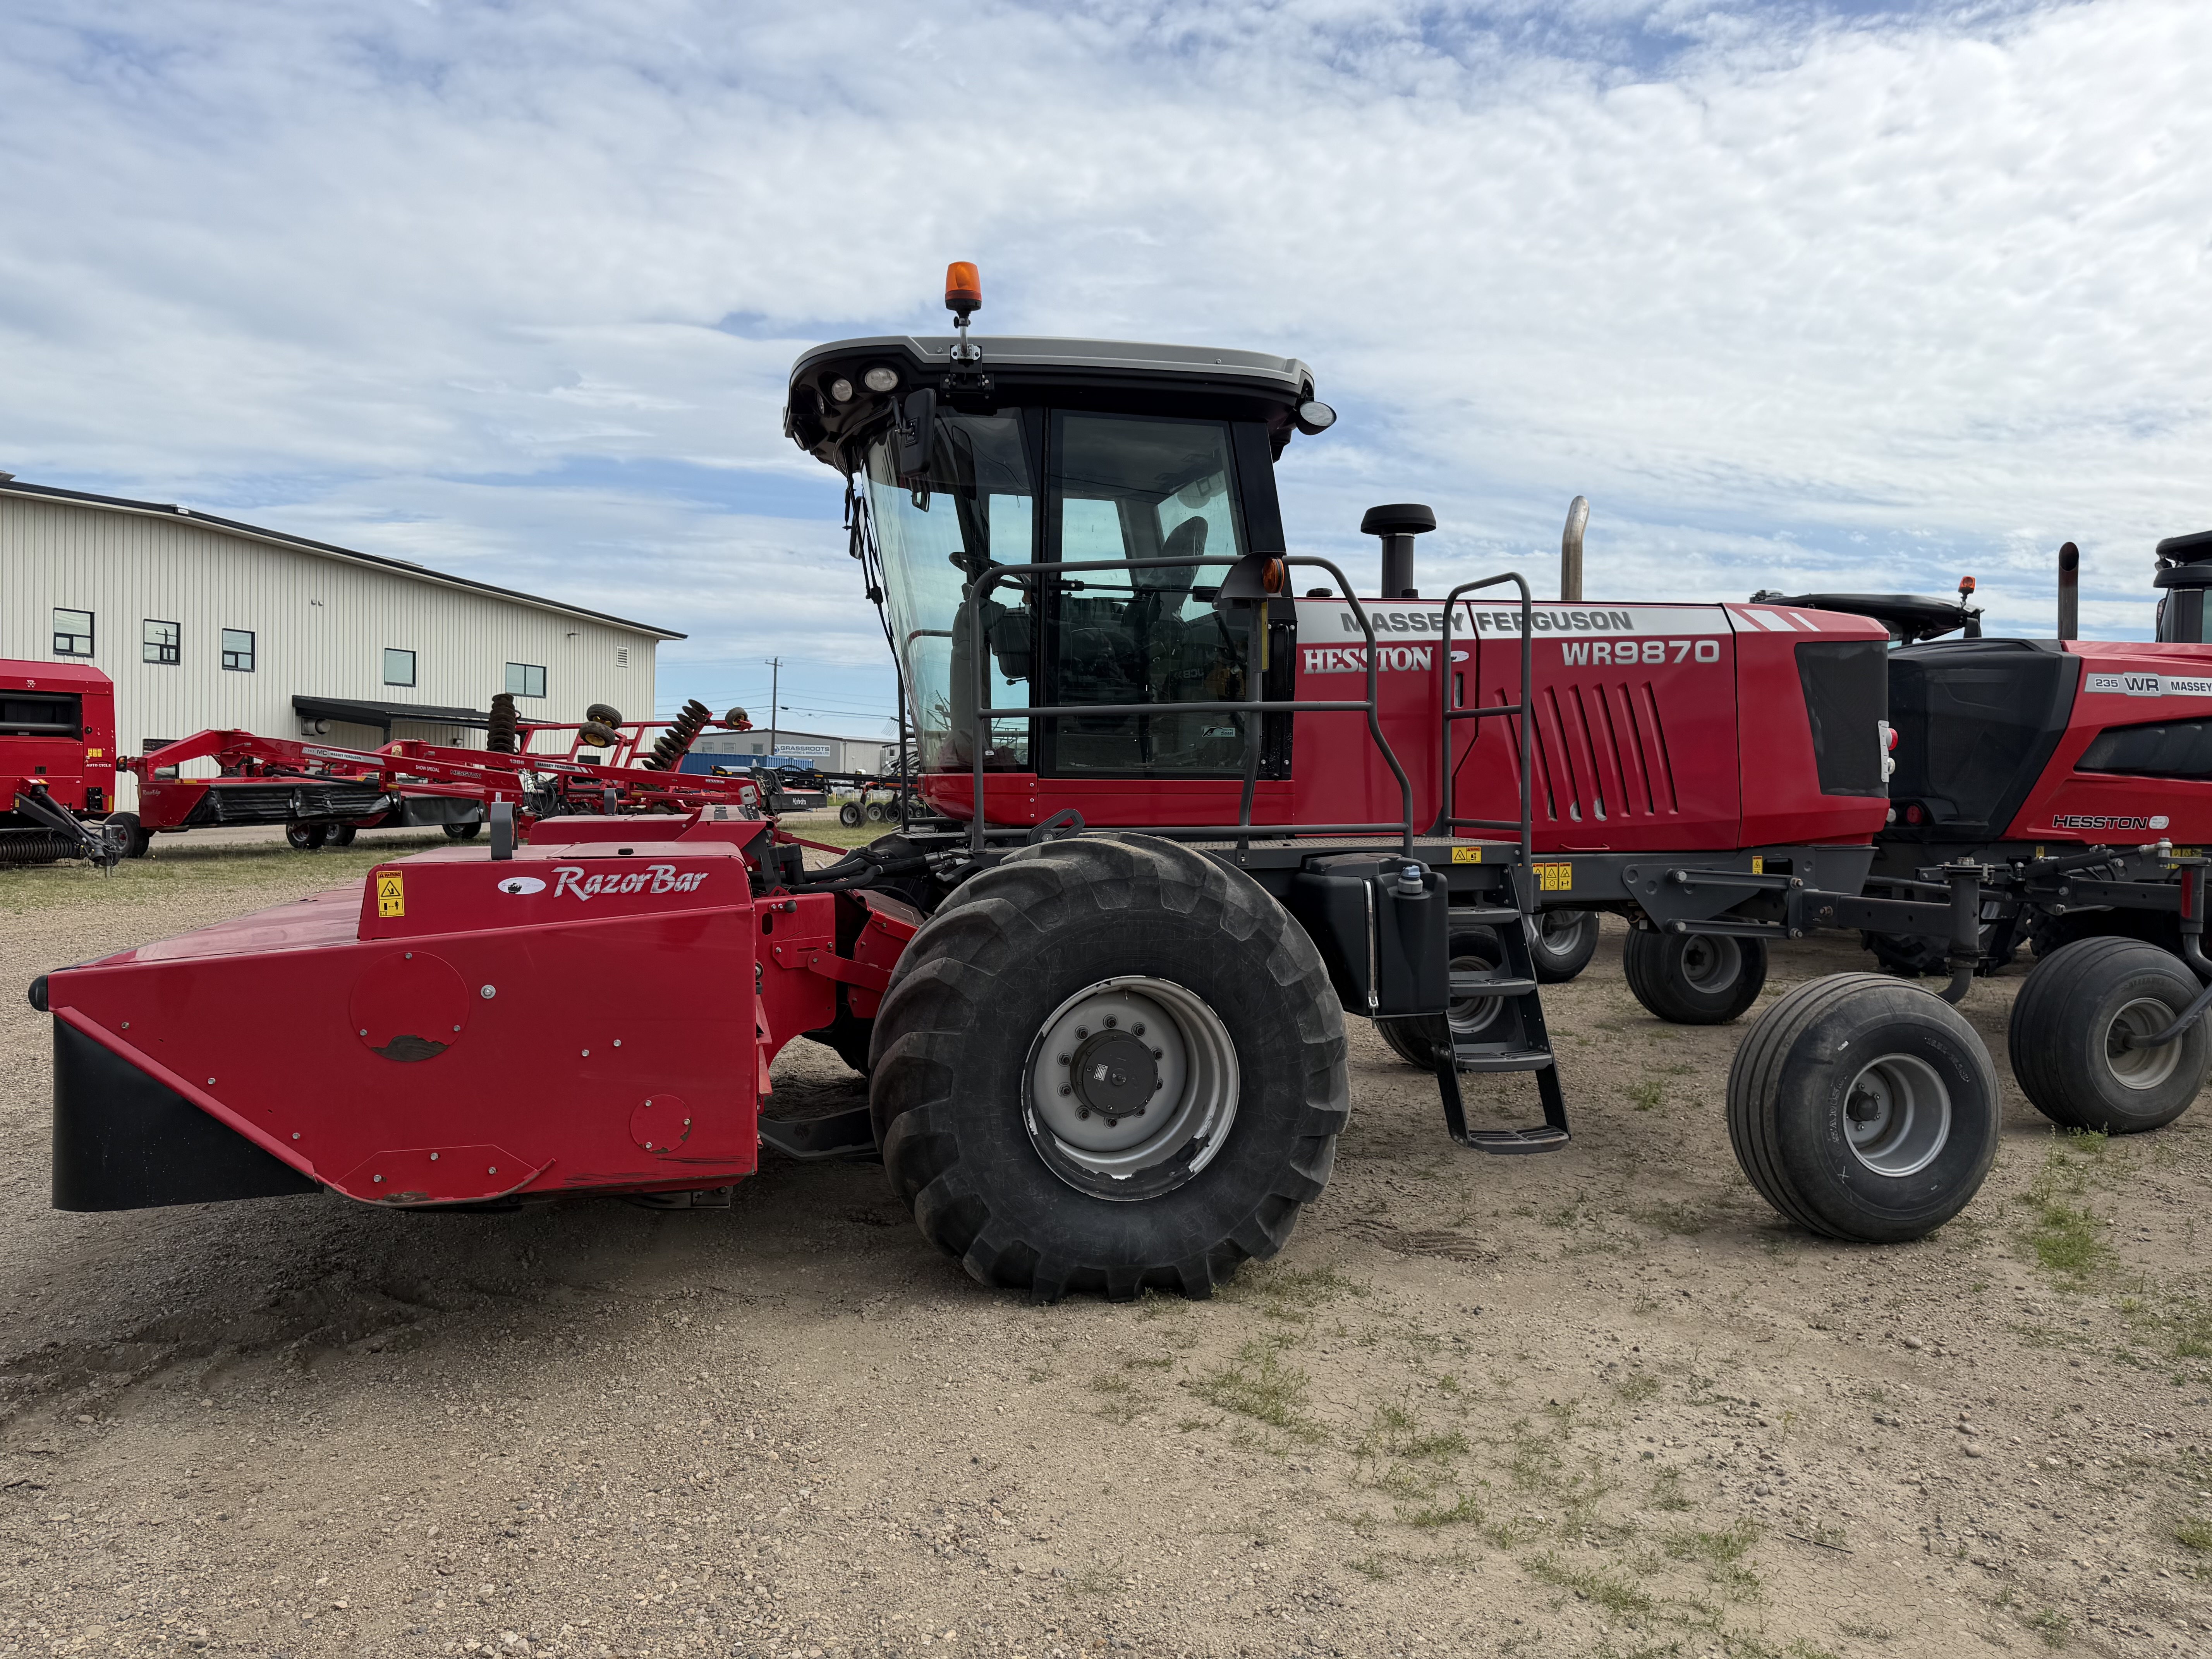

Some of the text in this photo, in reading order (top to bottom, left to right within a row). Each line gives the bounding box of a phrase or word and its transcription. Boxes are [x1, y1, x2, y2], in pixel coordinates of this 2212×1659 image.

[1340, 611, 1634, 632] MASSEY FERGUSON
[1304, 647, 1433, 674] HESSTON
[1561, 640, 1719, 666] WR9870
[2095, 677, 2212, 692] 235 WR MASSEY
[450, 769, 481, 779] HESSTON
[2052, 815, 2148, 830] HESSTON
[551, 865, 709, 901] RazorBar
